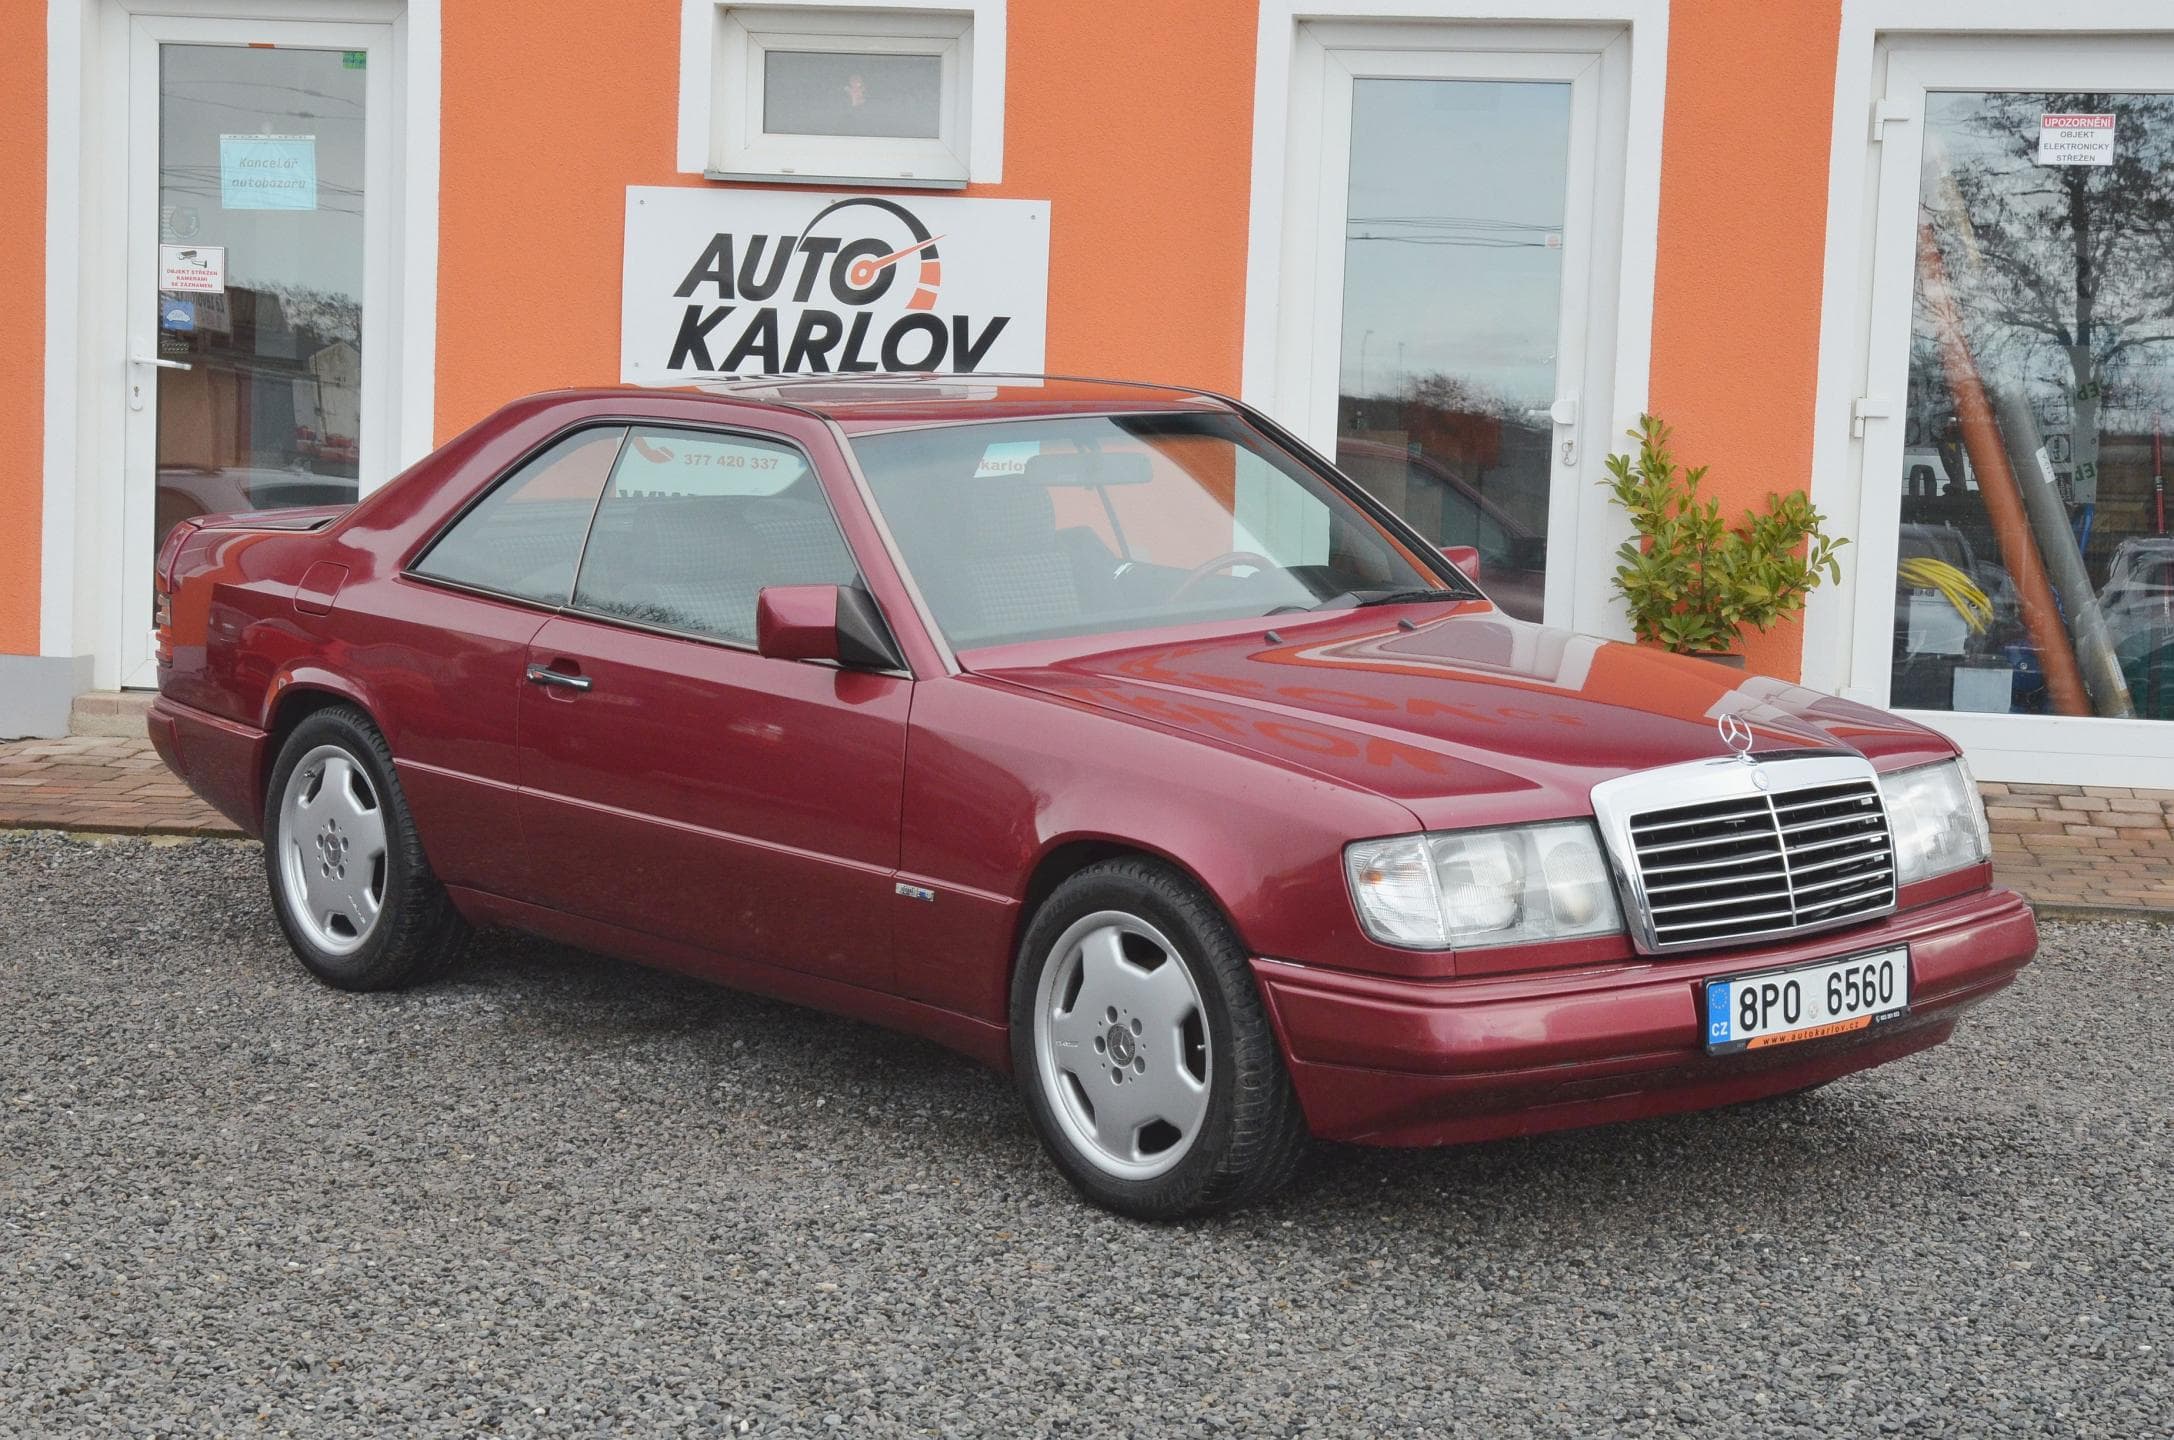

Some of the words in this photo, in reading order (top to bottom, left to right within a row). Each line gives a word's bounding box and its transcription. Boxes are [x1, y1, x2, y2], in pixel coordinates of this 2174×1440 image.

[2044, 117, 2112, 127] UPOZORNĚNÍ
[2043, 142, 2110, 151] ELEKTRONICKY
[2056, 154, 2096, 162] STŘEŽEN
[673, 231, 897, 306] AUTO
[666, 304, 1012, 374] KARLOV
[684, 454, 712, 467] 377
[716, 455, 745, 469] 420
[751, 457, 779, 470] 337
[1826, 959, 1894, 1016] 6560
[1711, 1020, 1729, 1038] CZ
[1762, 1020, 1860, 1046] www.autokarlov.cz
